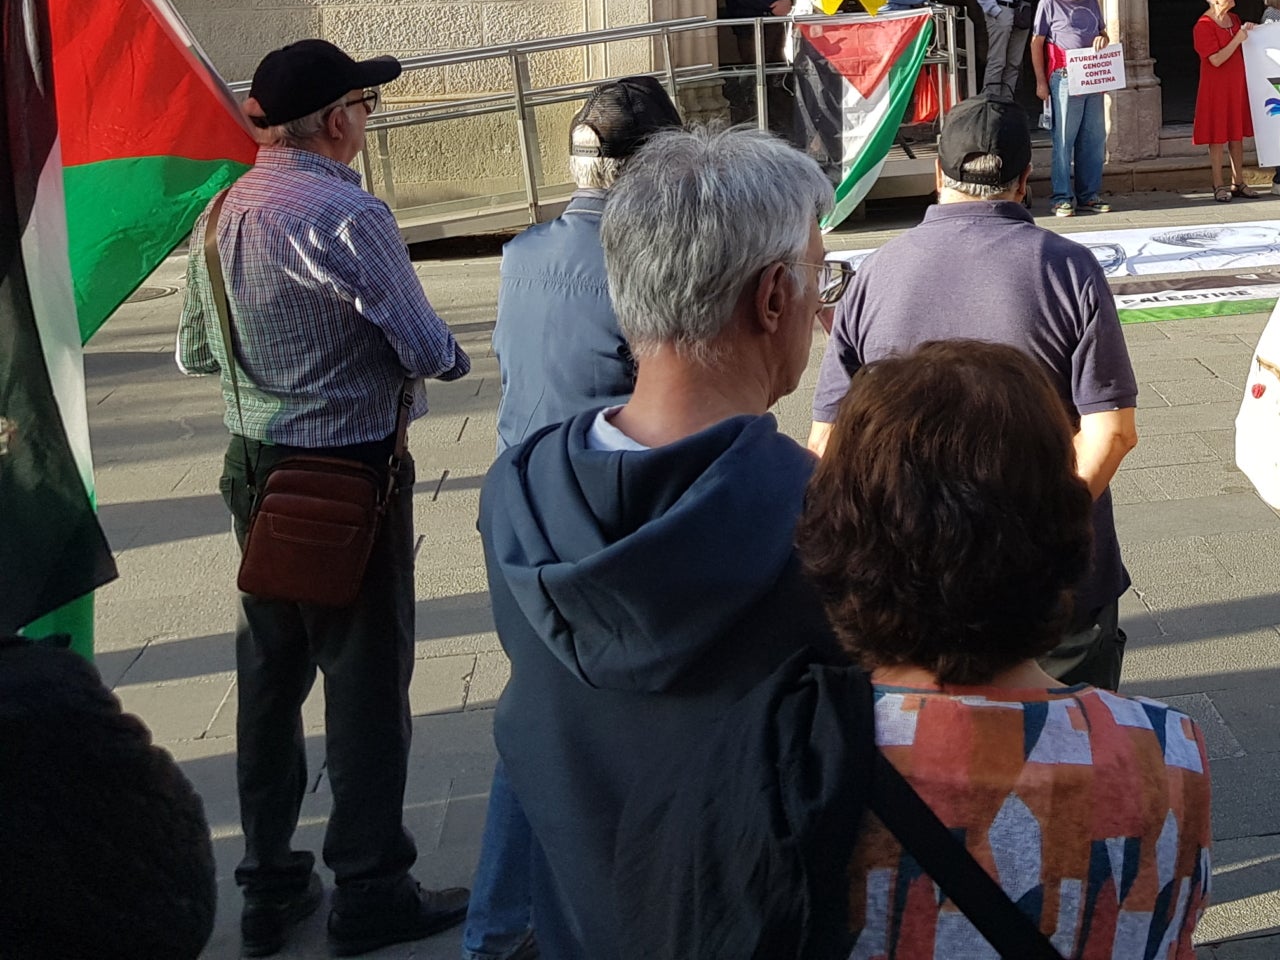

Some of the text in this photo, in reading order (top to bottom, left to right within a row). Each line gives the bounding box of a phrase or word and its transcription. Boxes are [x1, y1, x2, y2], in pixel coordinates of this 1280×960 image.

[1070, 51, 1121, 63] ATUREM AQUEST
[1085, 69, 1111, 78] CONTRA
[1081, 77, 1116, 86] PALESTINA
